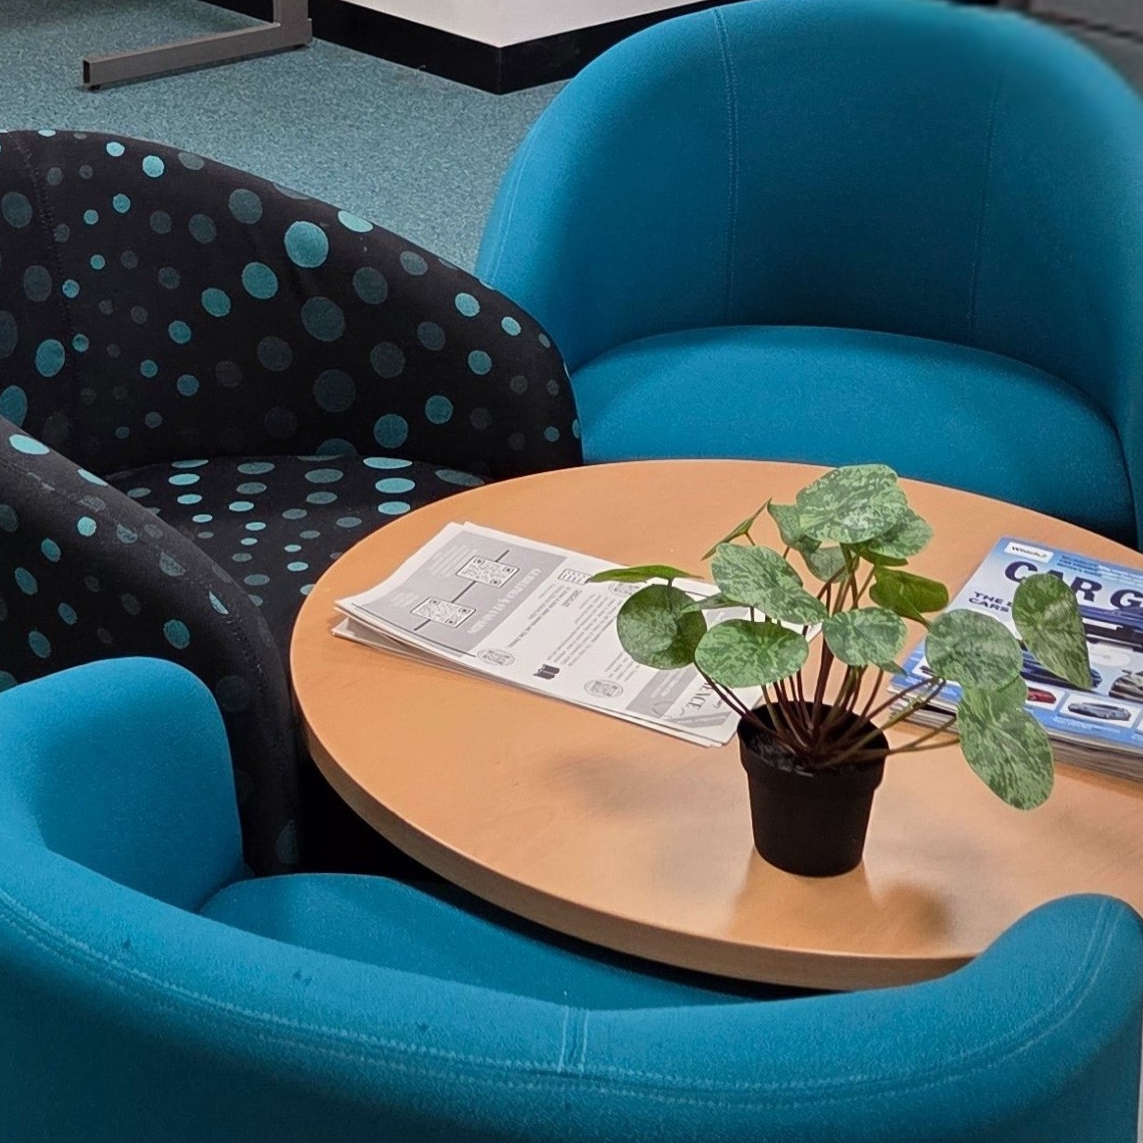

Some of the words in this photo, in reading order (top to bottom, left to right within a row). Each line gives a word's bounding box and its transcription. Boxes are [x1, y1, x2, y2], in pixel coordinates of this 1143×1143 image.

[1011, 545, 1048, 558] Which?
[1005, 560, 1102, 602] CR
[968, 598, 1010, 612] CARS
[973, 592, 1005, 605] THE
